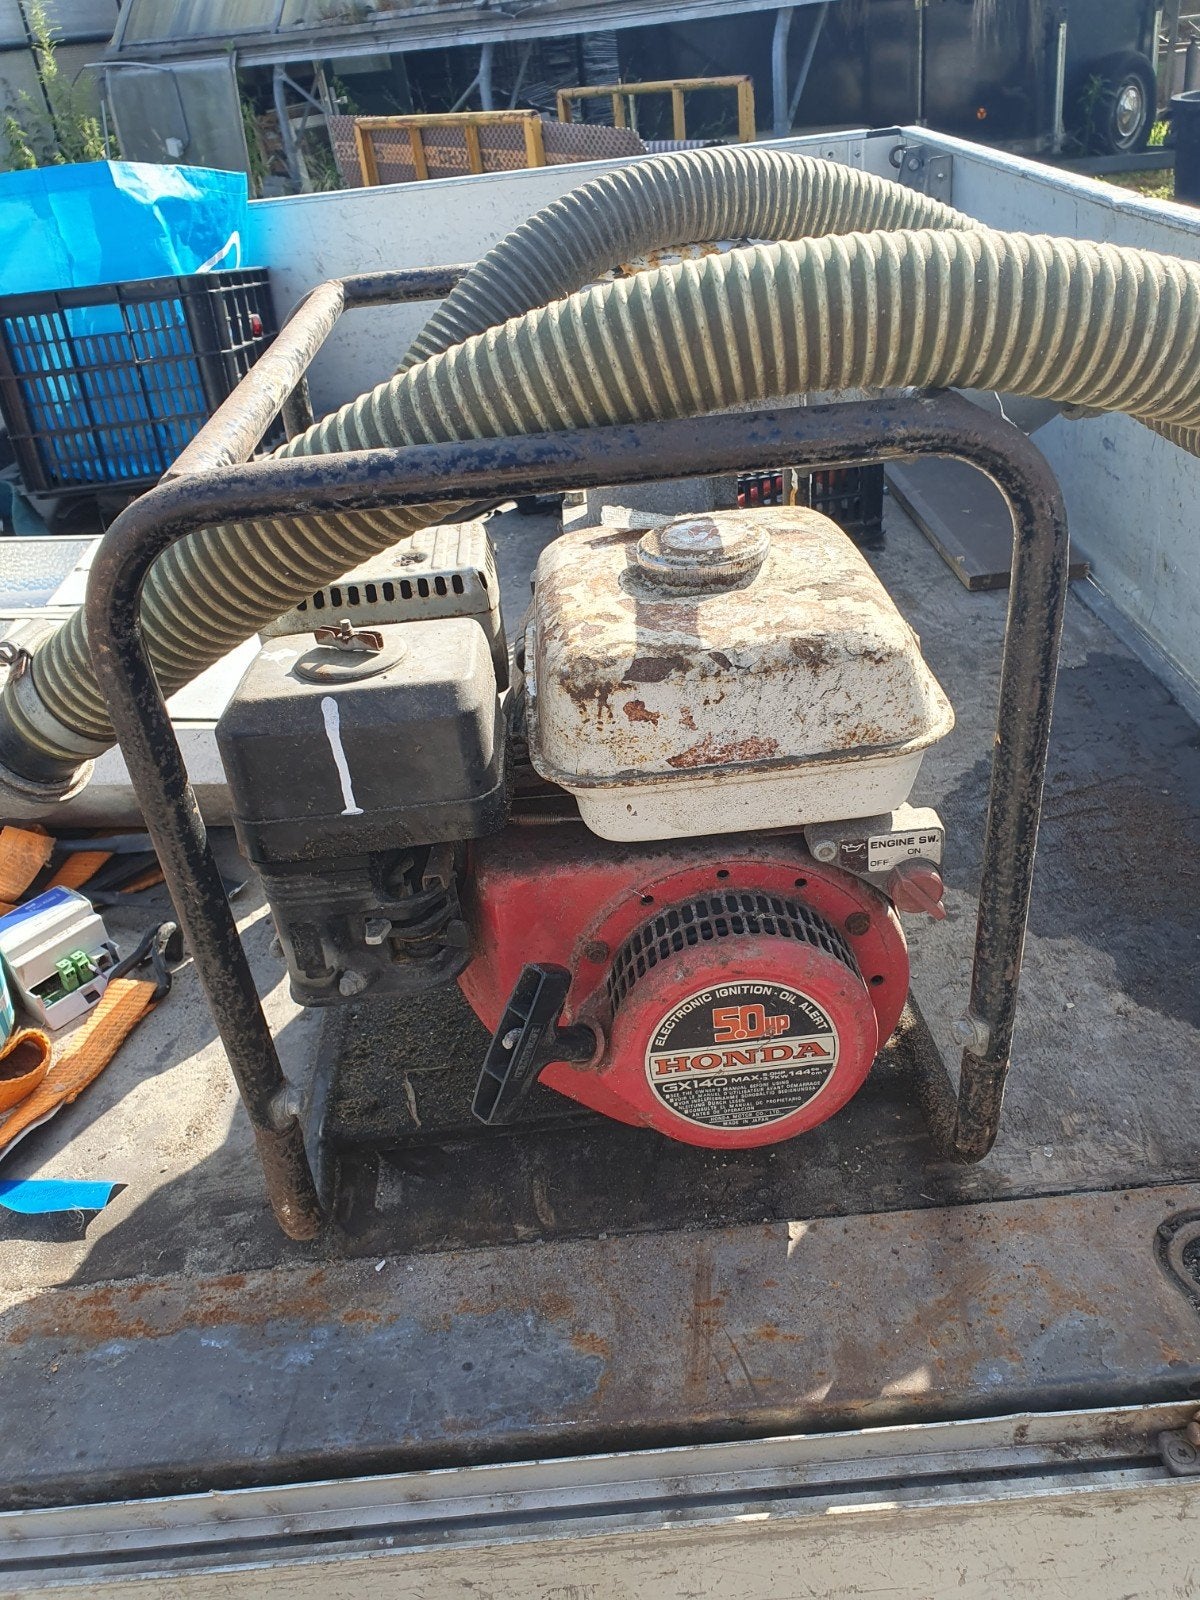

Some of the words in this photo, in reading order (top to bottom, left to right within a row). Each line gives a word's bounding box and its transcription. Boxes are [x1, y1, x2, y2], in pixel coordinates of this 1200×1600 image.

[870, 838, 914, 850] ENGINE
[918, 834, 939, 844] SW.
[655, 992, 713, 1048] ELECTRONIC
[716, 985, 772, 999] IGNITION
[779, 991, 796, 1005] OIL
[798, 1002, 828, 1030] ALERT
[655, 1041, 830, 1075] HONDA
[789, 1068, 811, 1076] 144
[662, 1078, 728, 1092] GX140
[732, 1075, 762, 1083] MAX.
